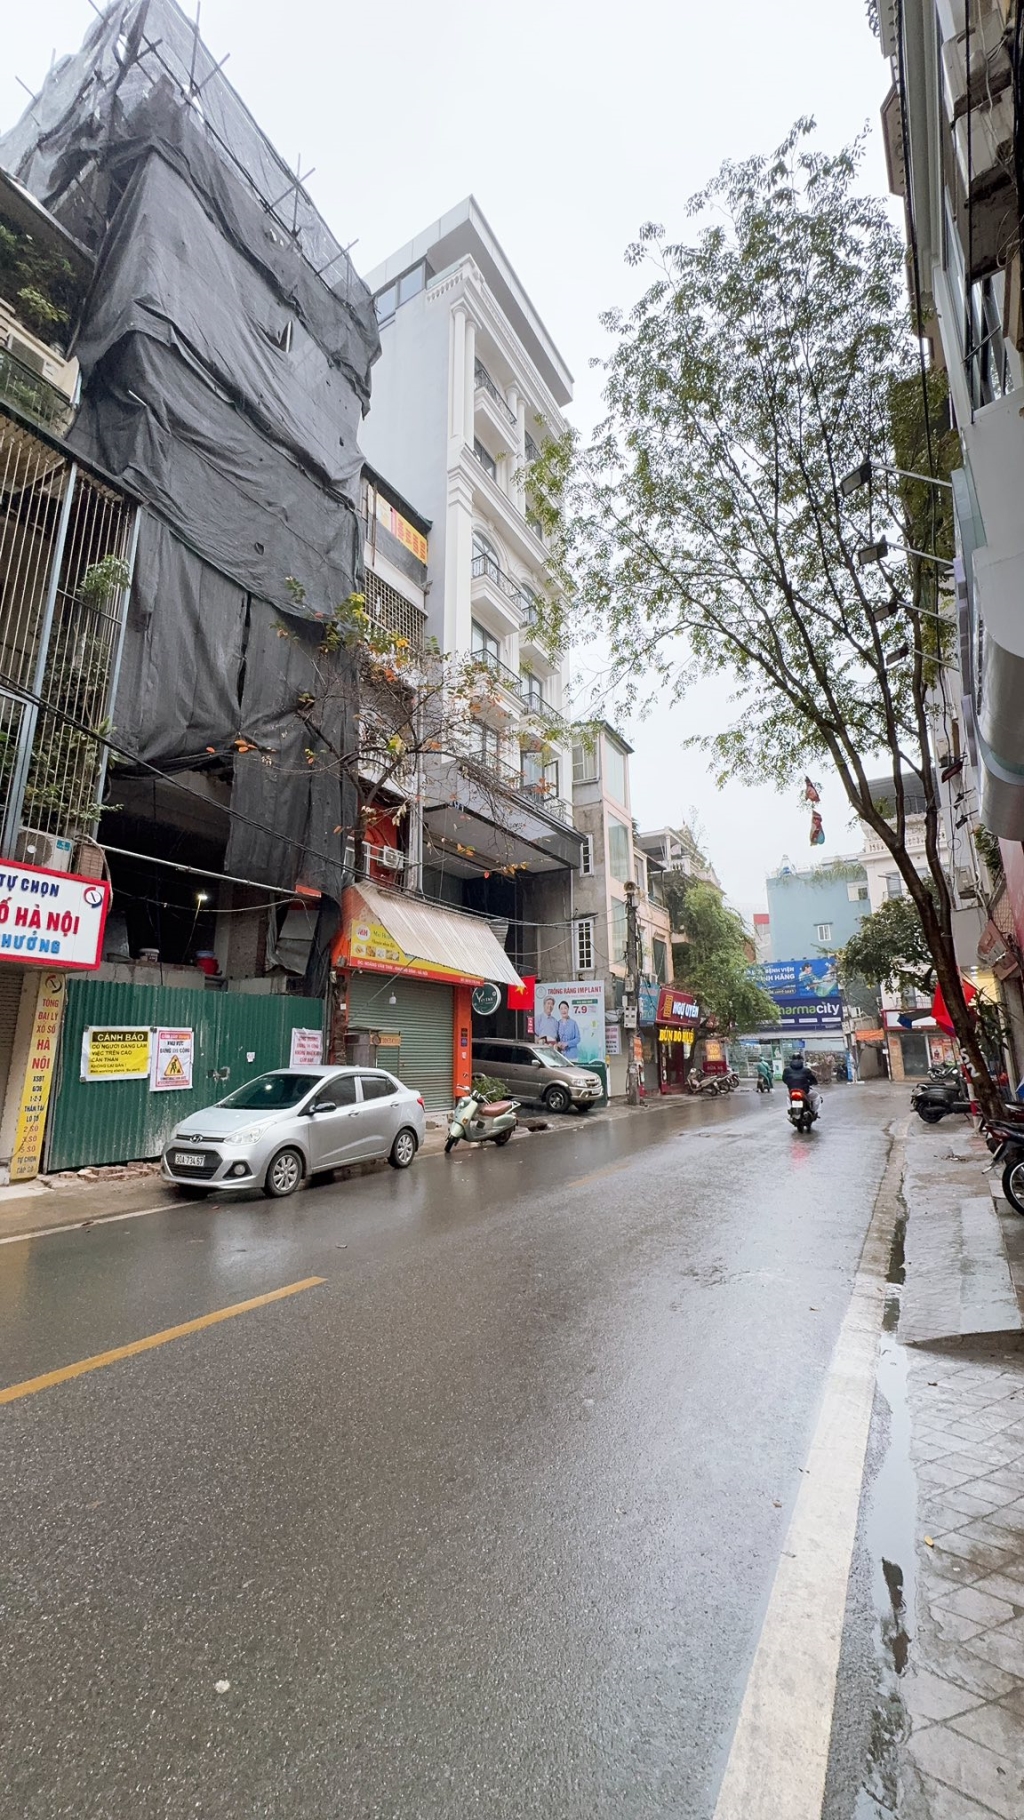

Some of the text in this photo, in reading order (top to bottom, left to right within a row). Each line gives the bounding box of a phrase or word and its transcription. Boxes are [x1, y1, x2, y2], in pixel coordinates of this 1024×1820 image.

[0, 873, 60, 898] TỰ CHỌN
[15, 904, 40, 929] HÀ
[46, 910, 80, 937] NỘI
[573, 1006, 587, 1014] 7.9
[775, 1002, 840, 1015] harmacity
[125, 1032, 144, 1041] BÁO
[37, 1037, 50, 1050] HÀ
[32, 1056, 50, 1072] NỘI
